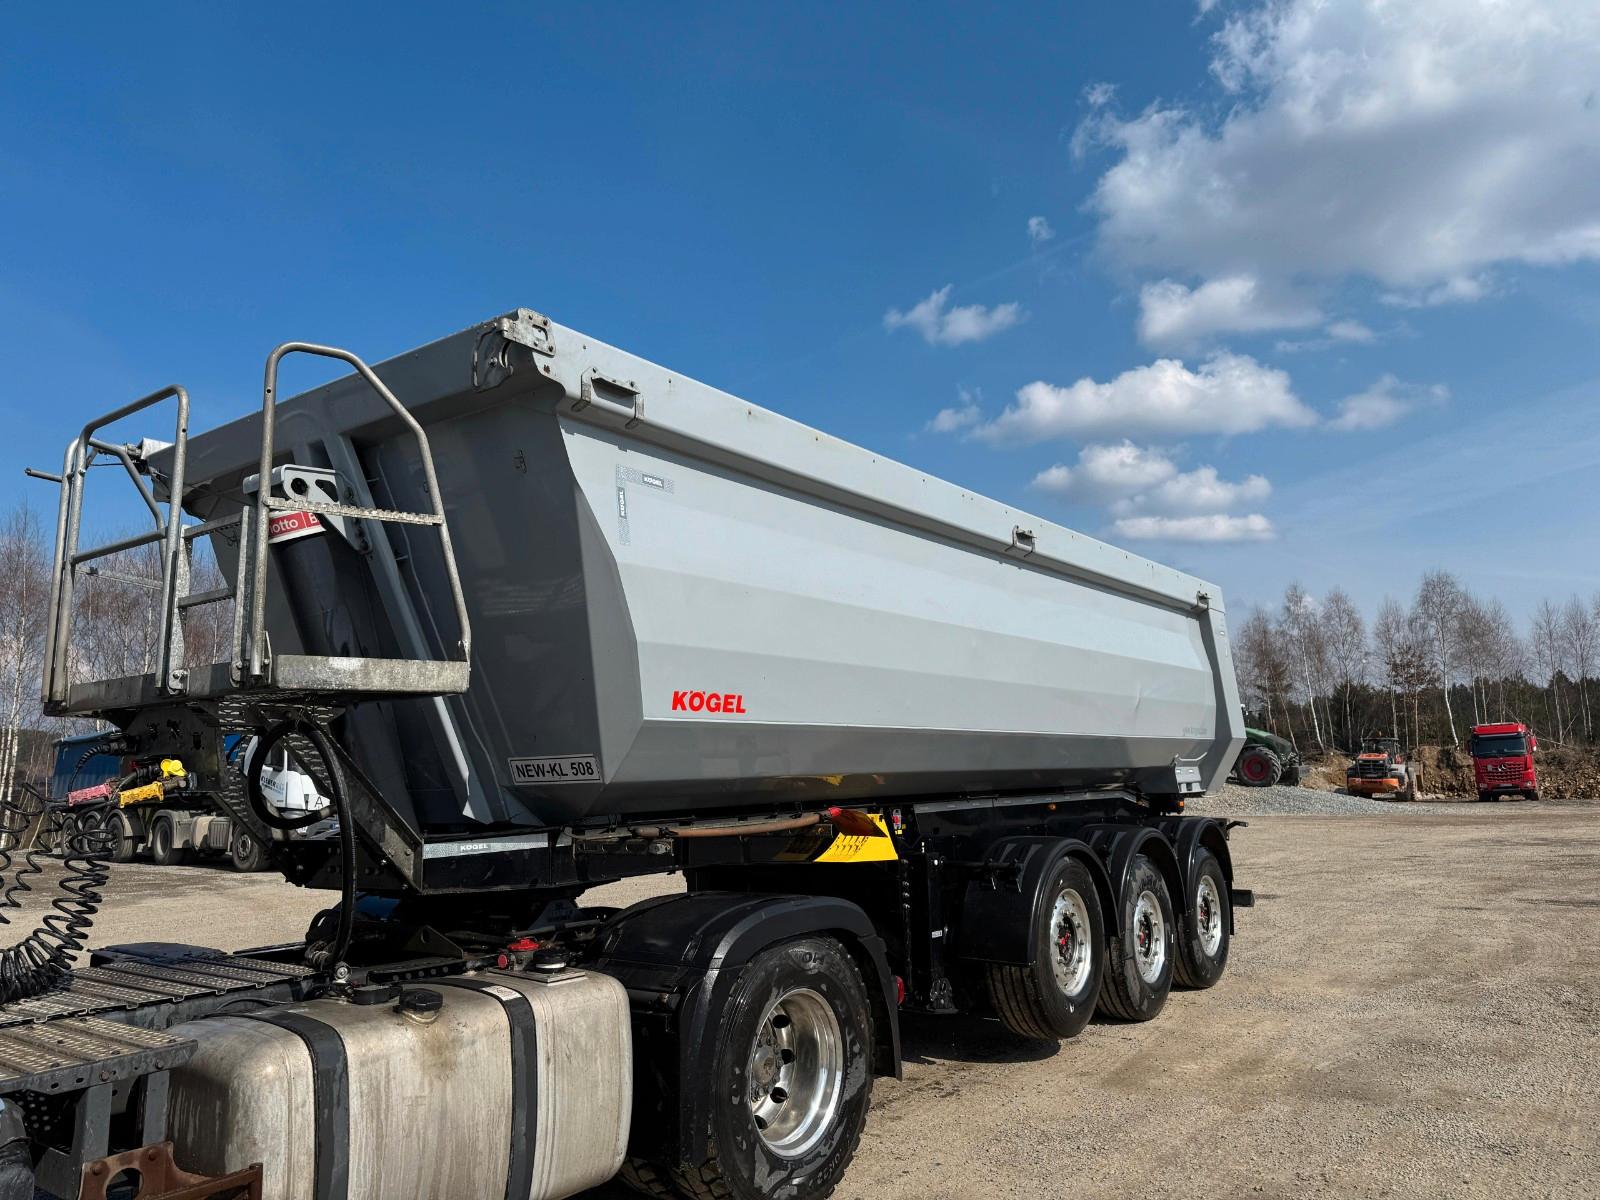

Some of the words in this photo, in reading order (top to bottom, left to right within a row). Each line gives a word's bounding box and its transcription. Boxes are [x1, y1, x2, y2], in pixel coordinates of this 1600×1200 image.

[671, 690, 746, 713] KÖGEL
[515, 763, 568, 778] NEW-KL
[571, 761, 594, 776] 508
